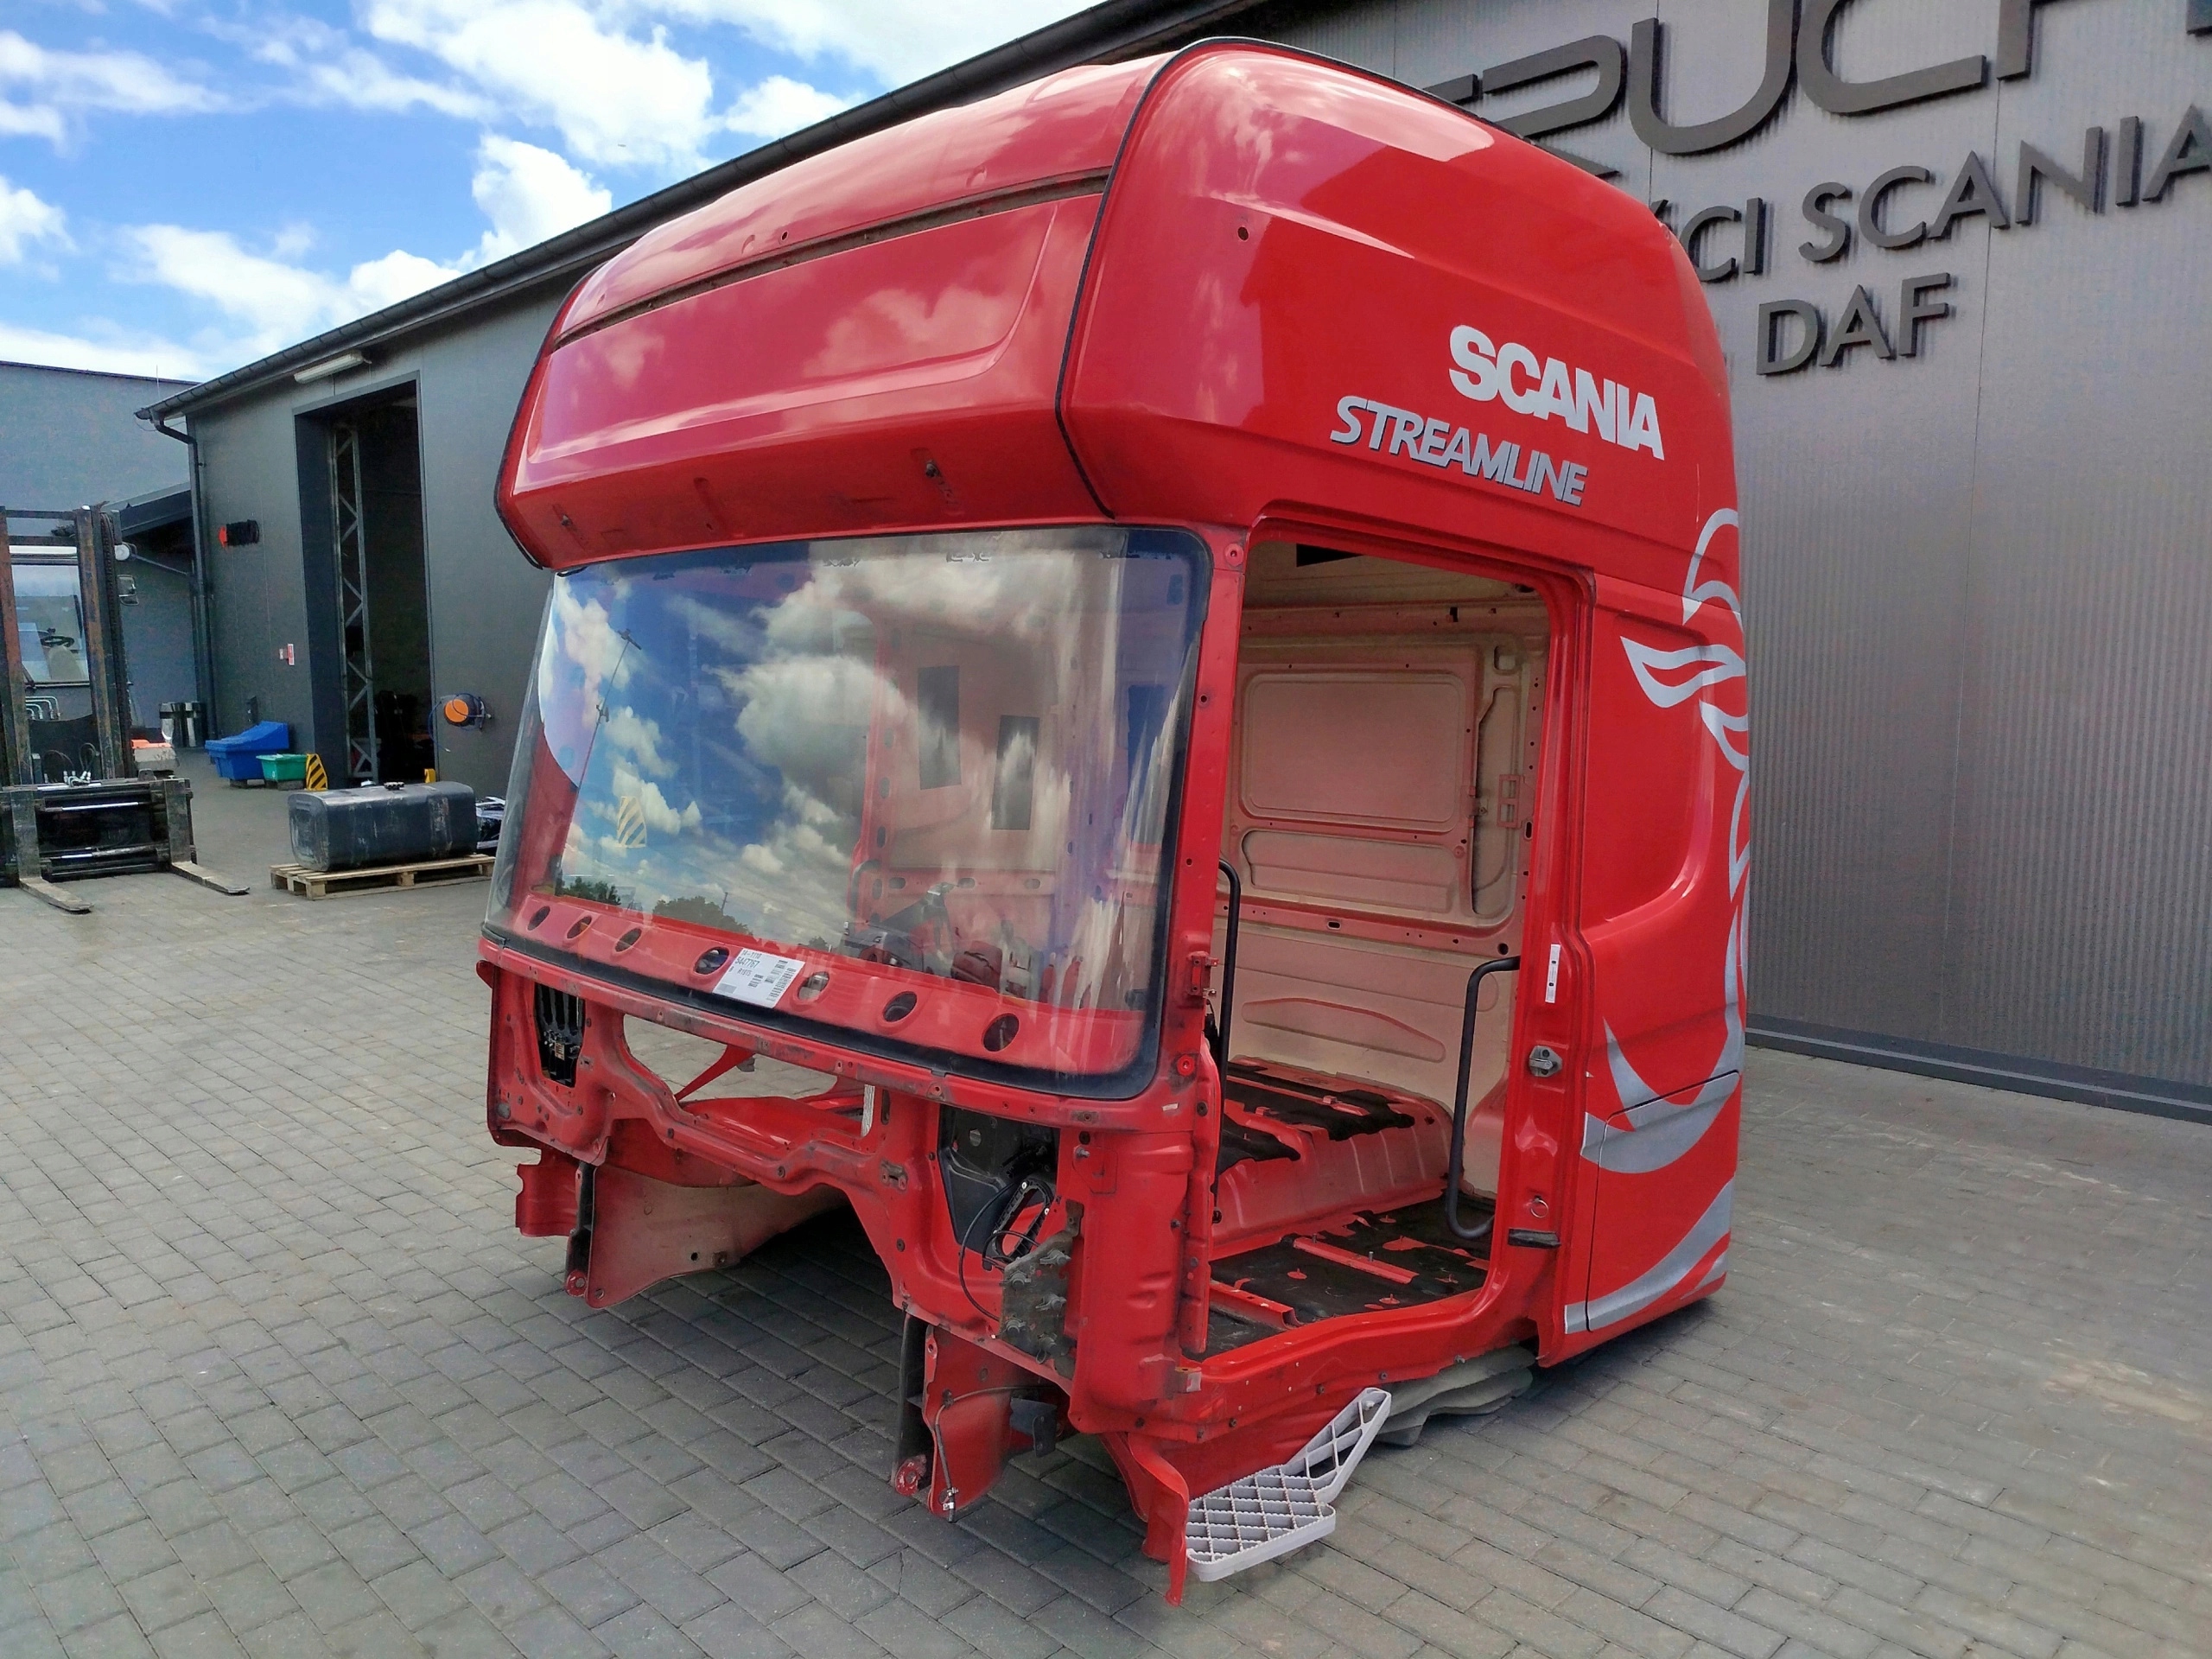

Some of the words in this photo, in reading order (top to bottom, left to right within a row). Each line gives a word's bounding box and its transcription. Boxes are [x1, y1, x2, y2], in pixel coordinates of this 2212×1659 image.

[1798, 104, 2212, 263] SCANIA
[1756, 272, 1951, 375] DAF
[1330, 395, 1588, 506] STREAMLINE
[1448, 323, 1665, 461] SCANIA
